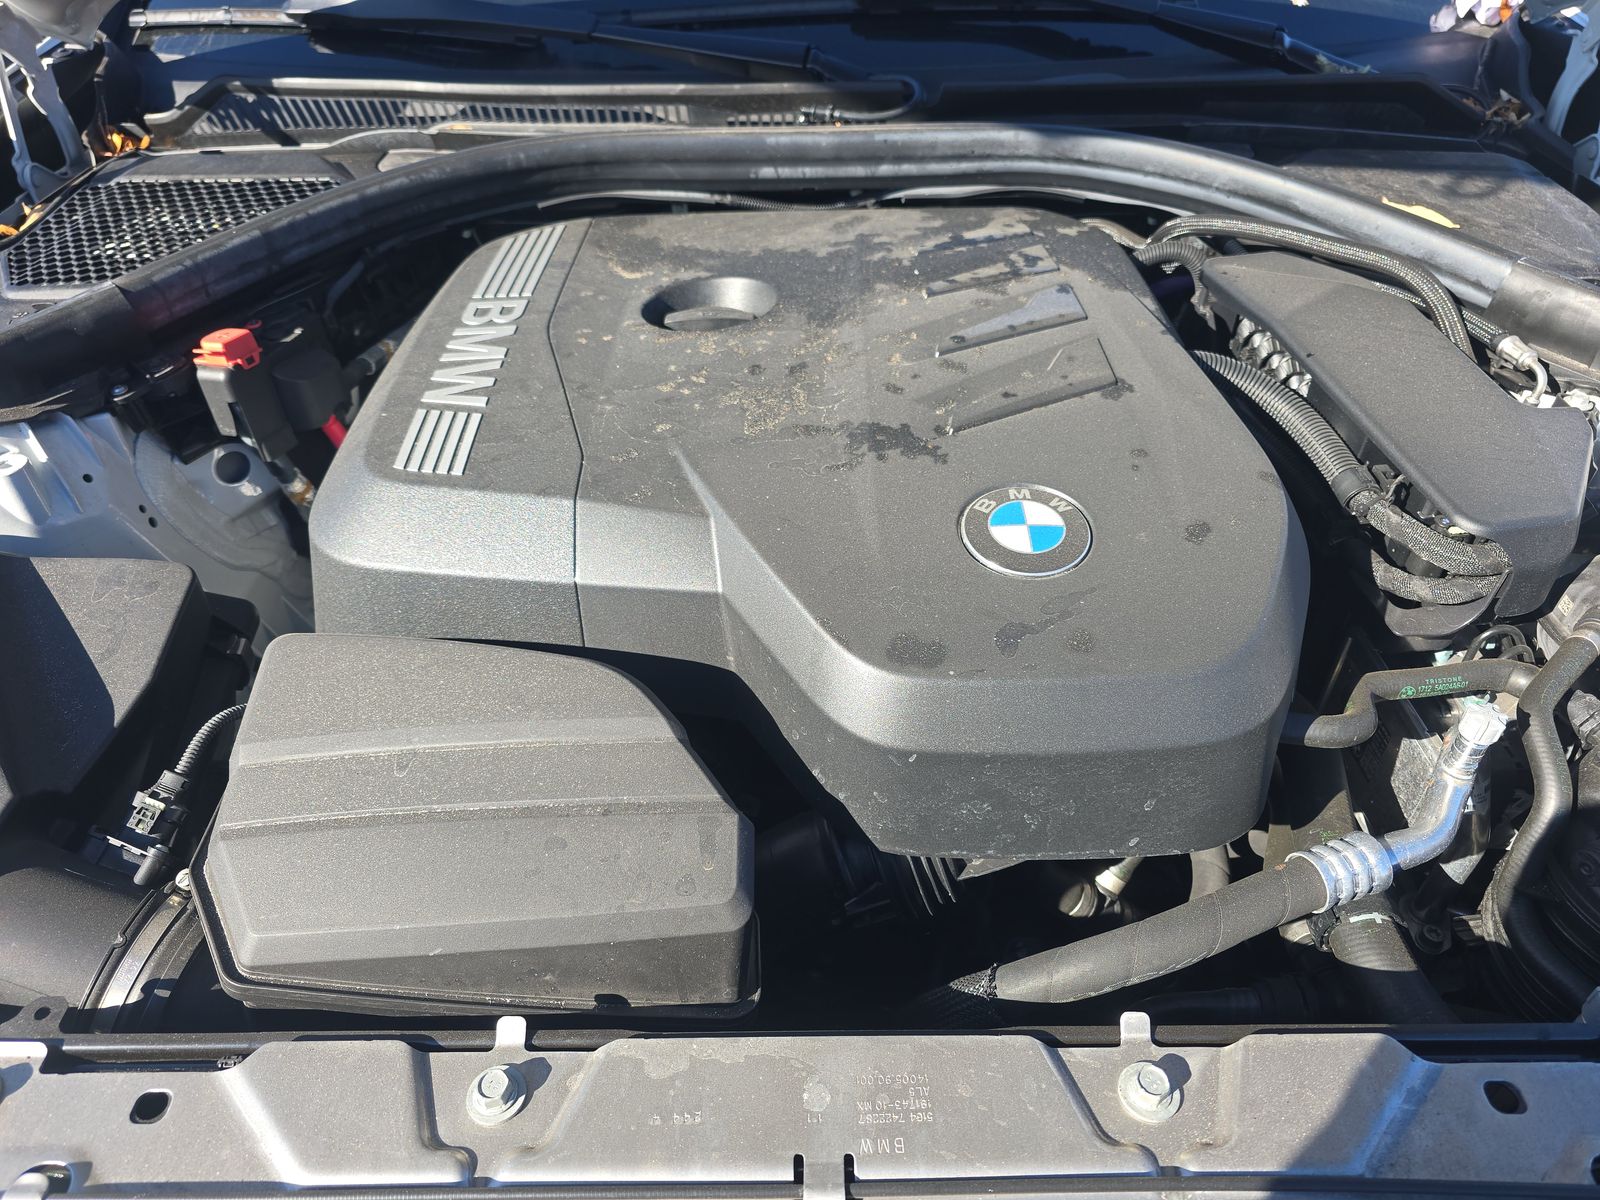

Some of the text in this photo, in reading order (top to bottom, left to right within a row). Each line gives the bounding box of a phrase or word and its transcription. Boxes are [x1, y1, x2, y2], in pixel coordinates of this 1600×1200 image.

[421, 299, 529, 407] BMW
[974, 488, 1073, 514] BMW
[1425, 676, 1462, 684] TRISTONE
[859, 1137, 905, 1154] BMW
